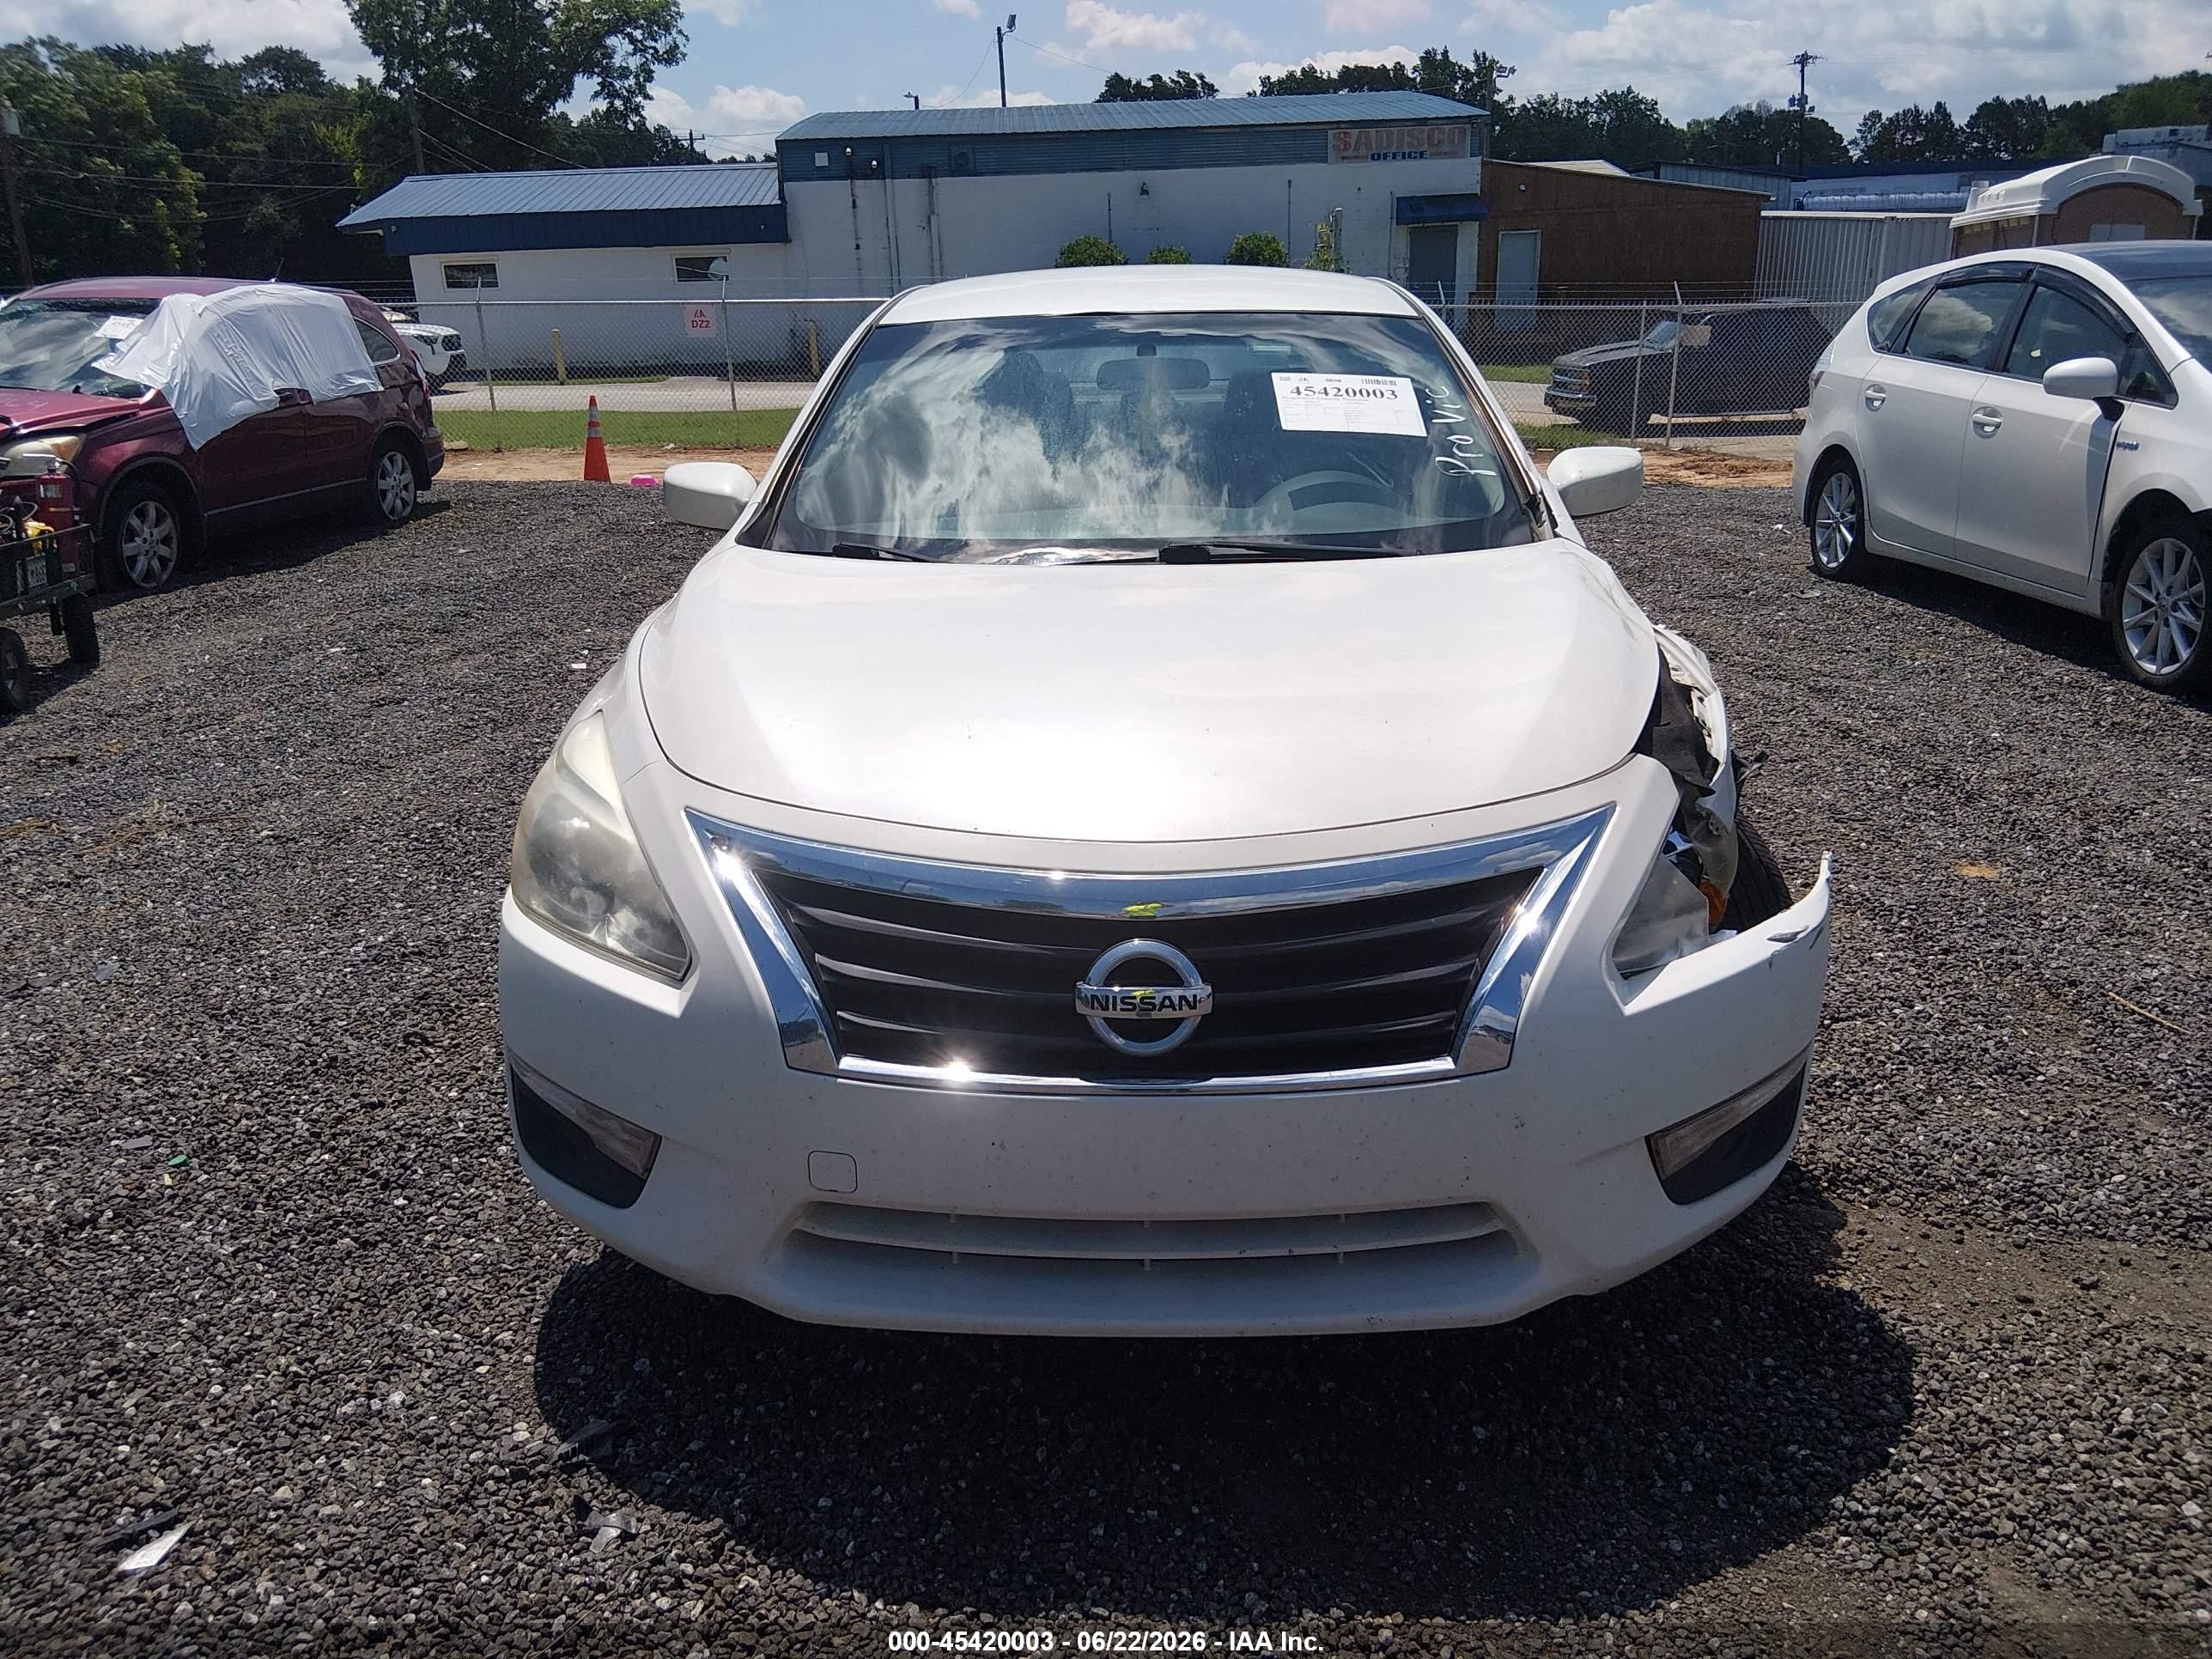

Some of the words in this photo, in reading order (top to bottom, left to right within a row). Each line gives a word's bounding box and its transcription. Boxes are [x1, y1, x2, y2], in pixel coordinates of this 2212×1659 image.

[1370, 150, 1428, 161] OFFICE
[691, 319, 711, 328] DZ2
[1290, 386, 1399, 400] 45420003
[1090, 994, 1198, 1012] NISSAN
